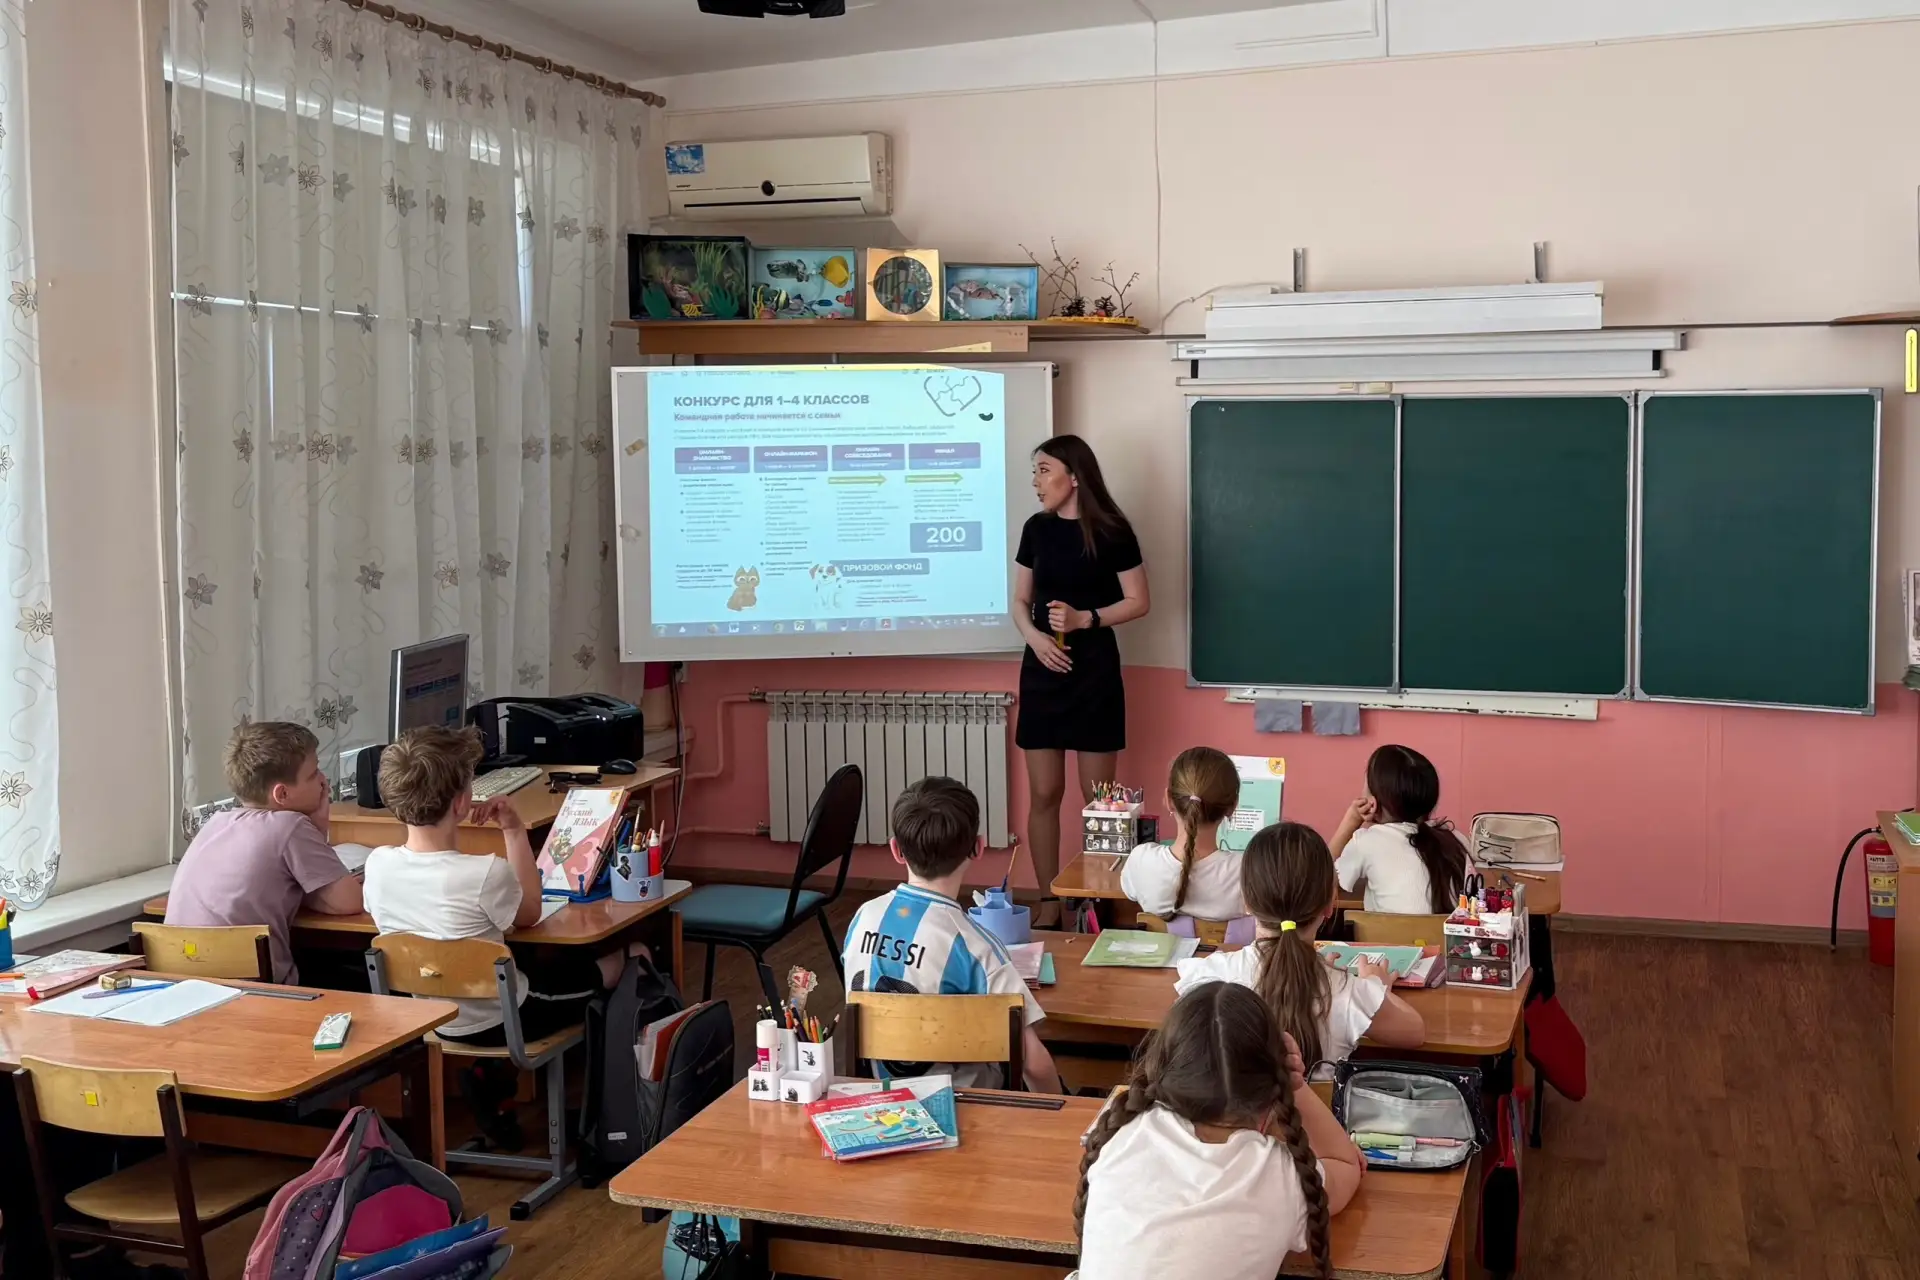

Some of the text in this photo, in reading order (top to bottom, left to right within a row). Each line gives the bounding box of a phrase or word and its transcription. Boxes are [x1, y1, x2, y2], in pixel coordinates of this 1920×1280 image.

[673, 396, 741, 407] КОНКУРС
[743, 395, 773, 408] ДЛЯ
[803, 394, 870, 405] КЛАССОВ
[673, 413, 723, 423] Командная
[724, 412, 755, 423] работа
[756, 412, 806, 421] начинается
[926, 525, 967, 544] 200
[894, 562, 923, 571] ФОНД
[570, 836, 601, 876] 3
[860, 930, 926, 969] MESSI
